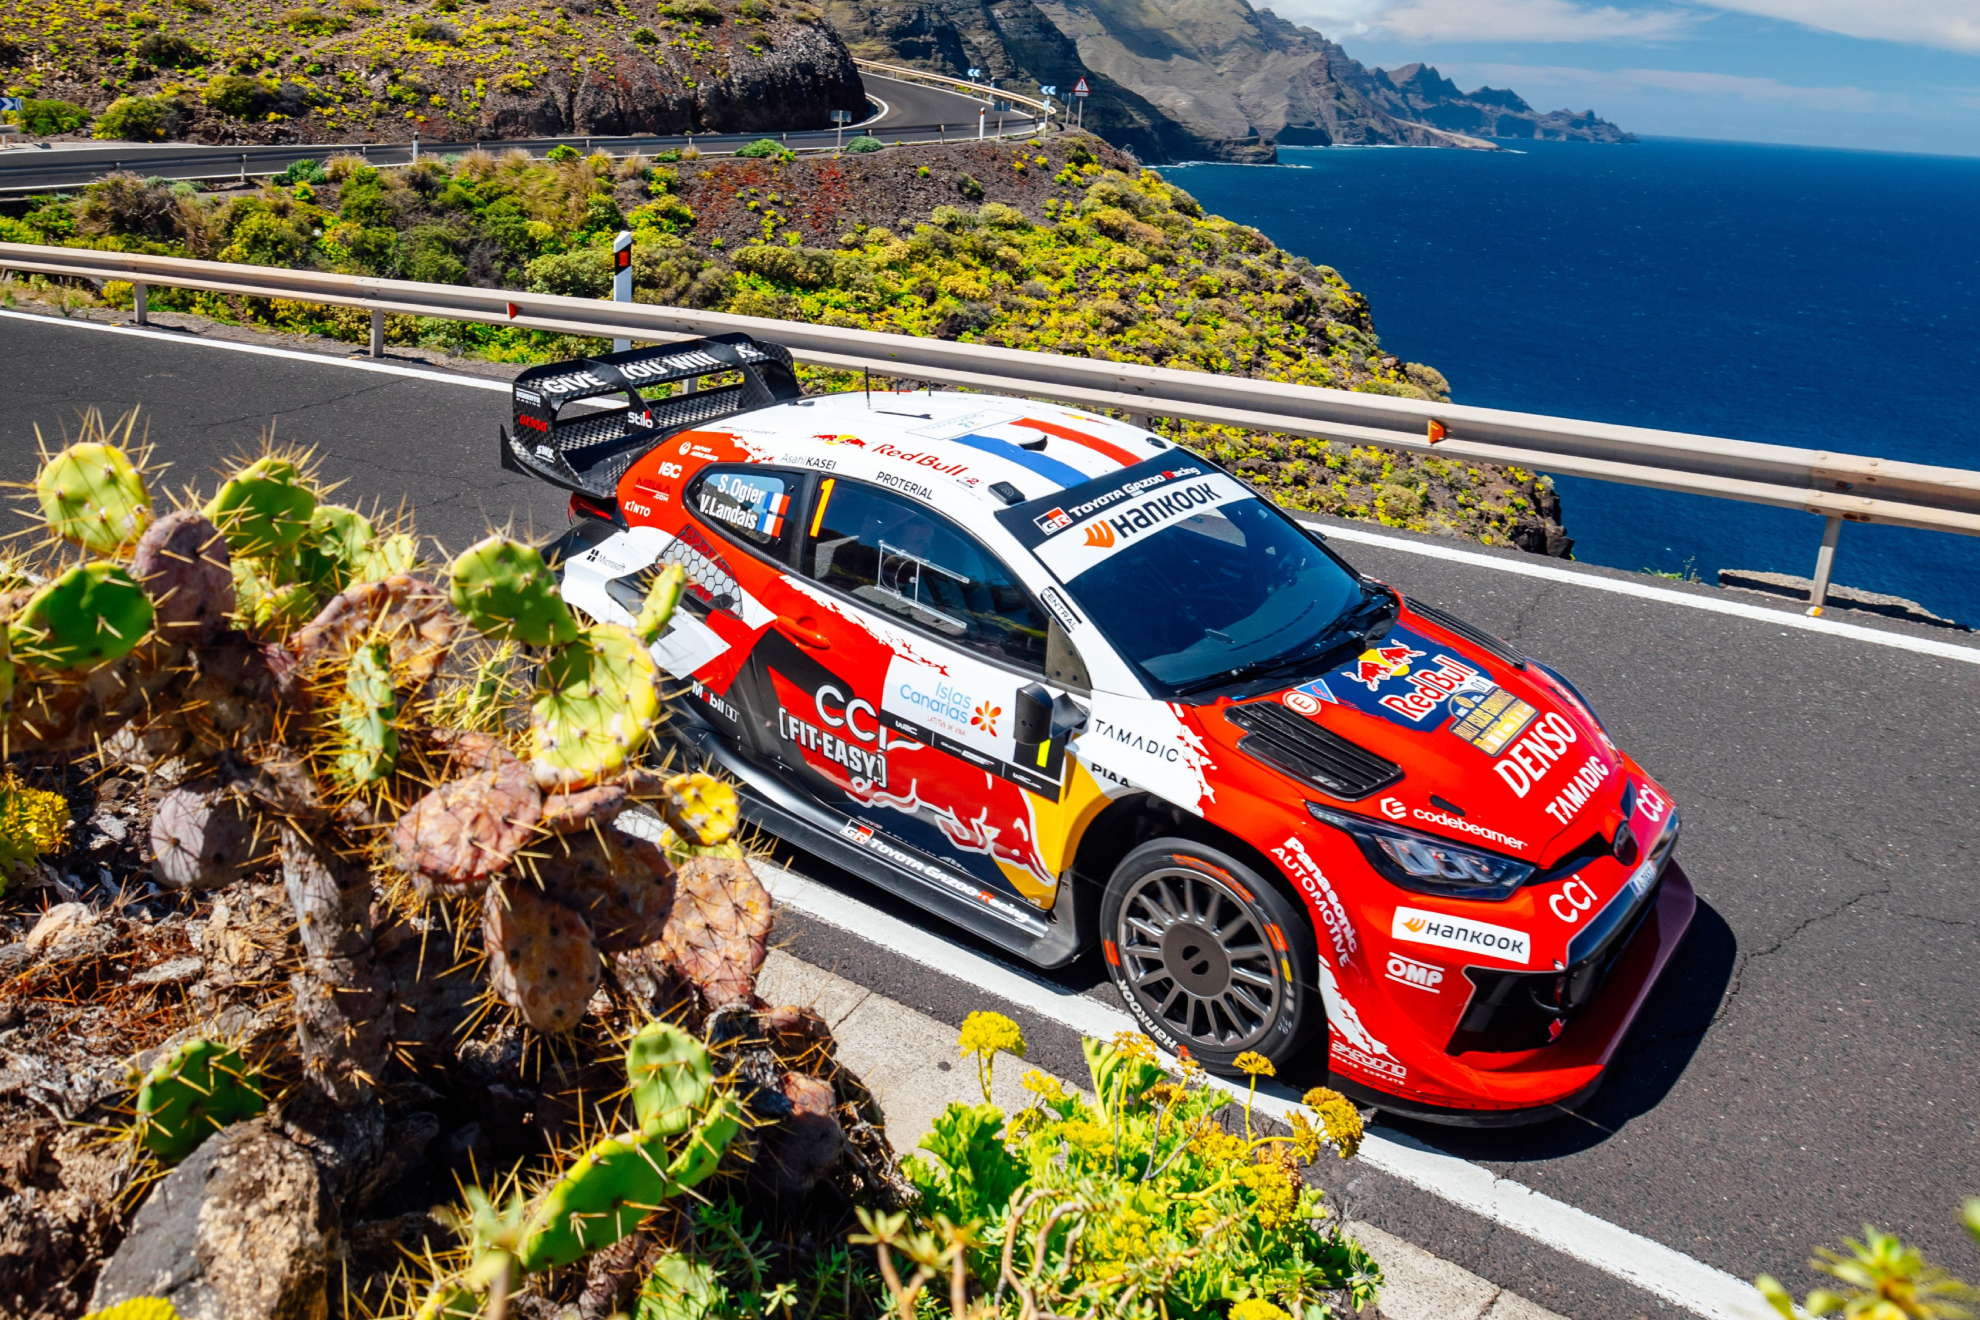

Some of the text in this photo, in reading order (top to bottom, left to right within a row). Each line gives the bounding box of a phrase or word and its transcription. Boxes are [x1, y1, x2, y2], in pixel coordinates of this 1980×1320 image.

[542, 373, 607, 394] GIVE
[519, 414, 548, 432] DENSO
[628, 411, 653, 429] Stilo
[875, 471, 934, 501] PROTERIAL
[1068, 467, 1202, 517] TOYOTA GAZOO Racing
[624, 500, 651, 517] KINTO
[809, 478, 836, 538] 1
[597, 554, 626, 573] Microsoft
[1042, 587, 1077, 631] CENTRAL
[691, 680, 725, 714] Mobil
[899, 683, 968, 725] Canarias
[935, 682, 972, 709] Islas
[1382, 677, 1447, 720] Red
[1417, 655, 1476, 692] Bull
[1094, 718, 1180, 763] TAMADIC
[1493, 711, 1578, 799] DENSO
[1091, 763, 1131, 788] PIAA
[1545, 755, 1609, 826] TAMADIC
[1412, 808, 1524, 851] codebeamer
[869, 837, 923, 871] TOYOTA
[923, 864, 979, 897] GAZOO
[1271, 847, 1350, 967] AUTOMOTIVE
[1284, 836, 1358, 955] Panasonic
[1386, 957, 1444, 987] OMP
